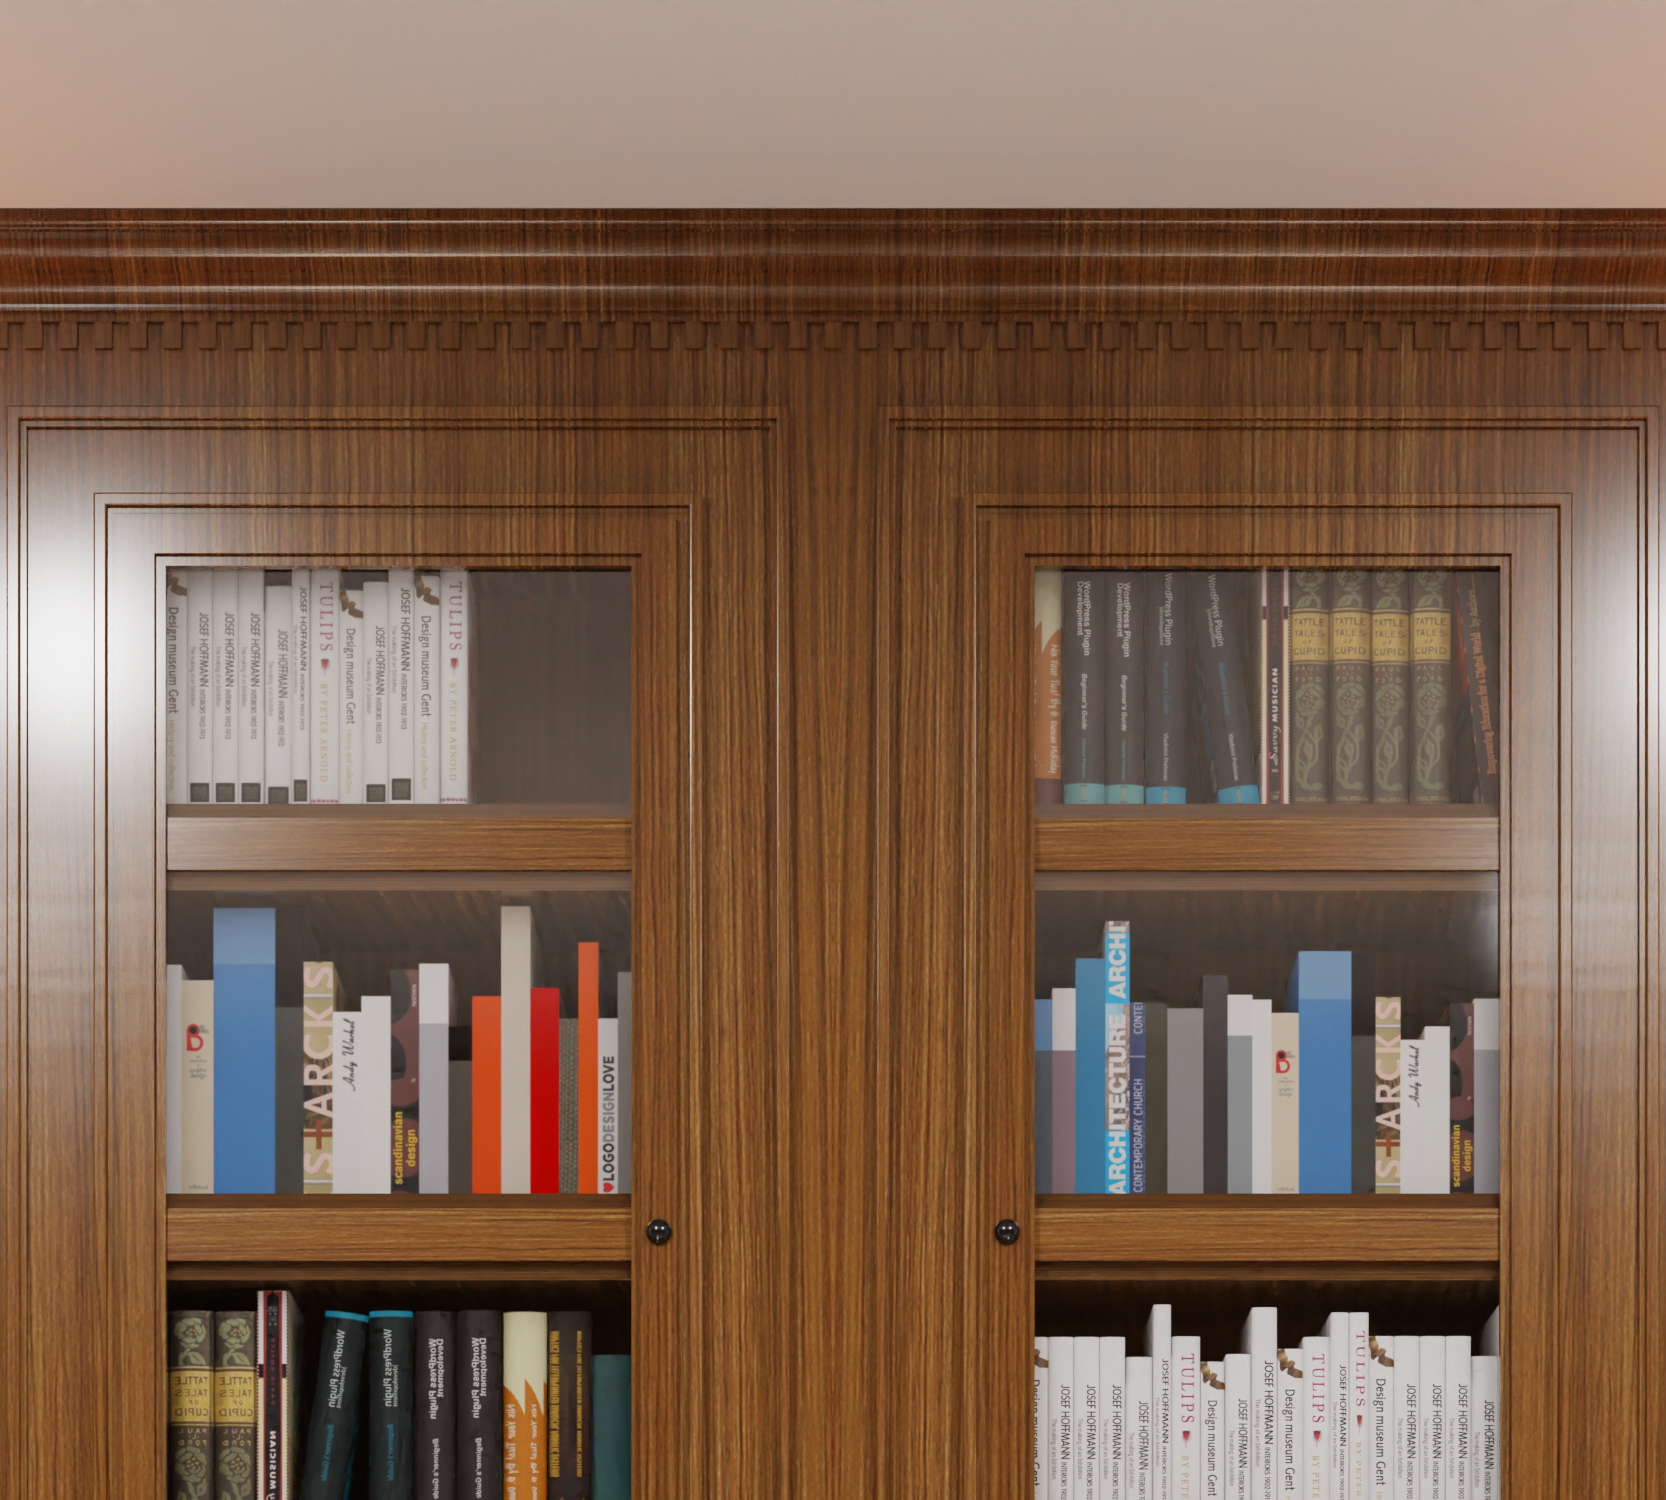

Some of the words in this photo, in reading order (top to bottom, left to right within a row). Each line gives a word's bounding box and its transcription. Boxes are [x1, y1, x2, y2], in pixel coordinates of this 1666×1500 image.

[448, 579, 464, 650] TULIPS
[1413, 617, 1449, 628] TATTLE
[1413, 645, 1449, 656] CUPID
[1415, 629, 1449, 639] TALES
[1471, 633, 1482, 654] World
[1473, 656, 1486, 678] Digital
[449, 681, 457, 693] BY
[1478, 685, 1488, 695] for
[1480, 696, 1490, 730] Education
[1269, 726, 1282, 765] Savvy
[1485, 731, 1497, 774] Empowering
[410, 983, 418, 1008] TASCHEN
[342, 1018, 354, 1056] Warhol
[343, 1062, 357, 1091] Andy
[1106, 1013, 1129, 1194] ARCHITECTURE
[1132, 1077, 1144, 1115] CHURCH
[393, 1110, 405, 1186] scandinavian
[406, 1128, 419, 1169] design
[1132, 1119, 1145, 1194] CONTEMPORARY
[1451, 1123, 1462, 1189] scandinavian
[1462, 1138, 1473, 1173] design
[1182, 1354, 1194, 1422] TULIPS
[1264, 1361, 1274, 1388] JOSEF
[1265, 1391, 1274, 1444] HOFFMANN
[1181, 1456, 1189, 1468] BY
